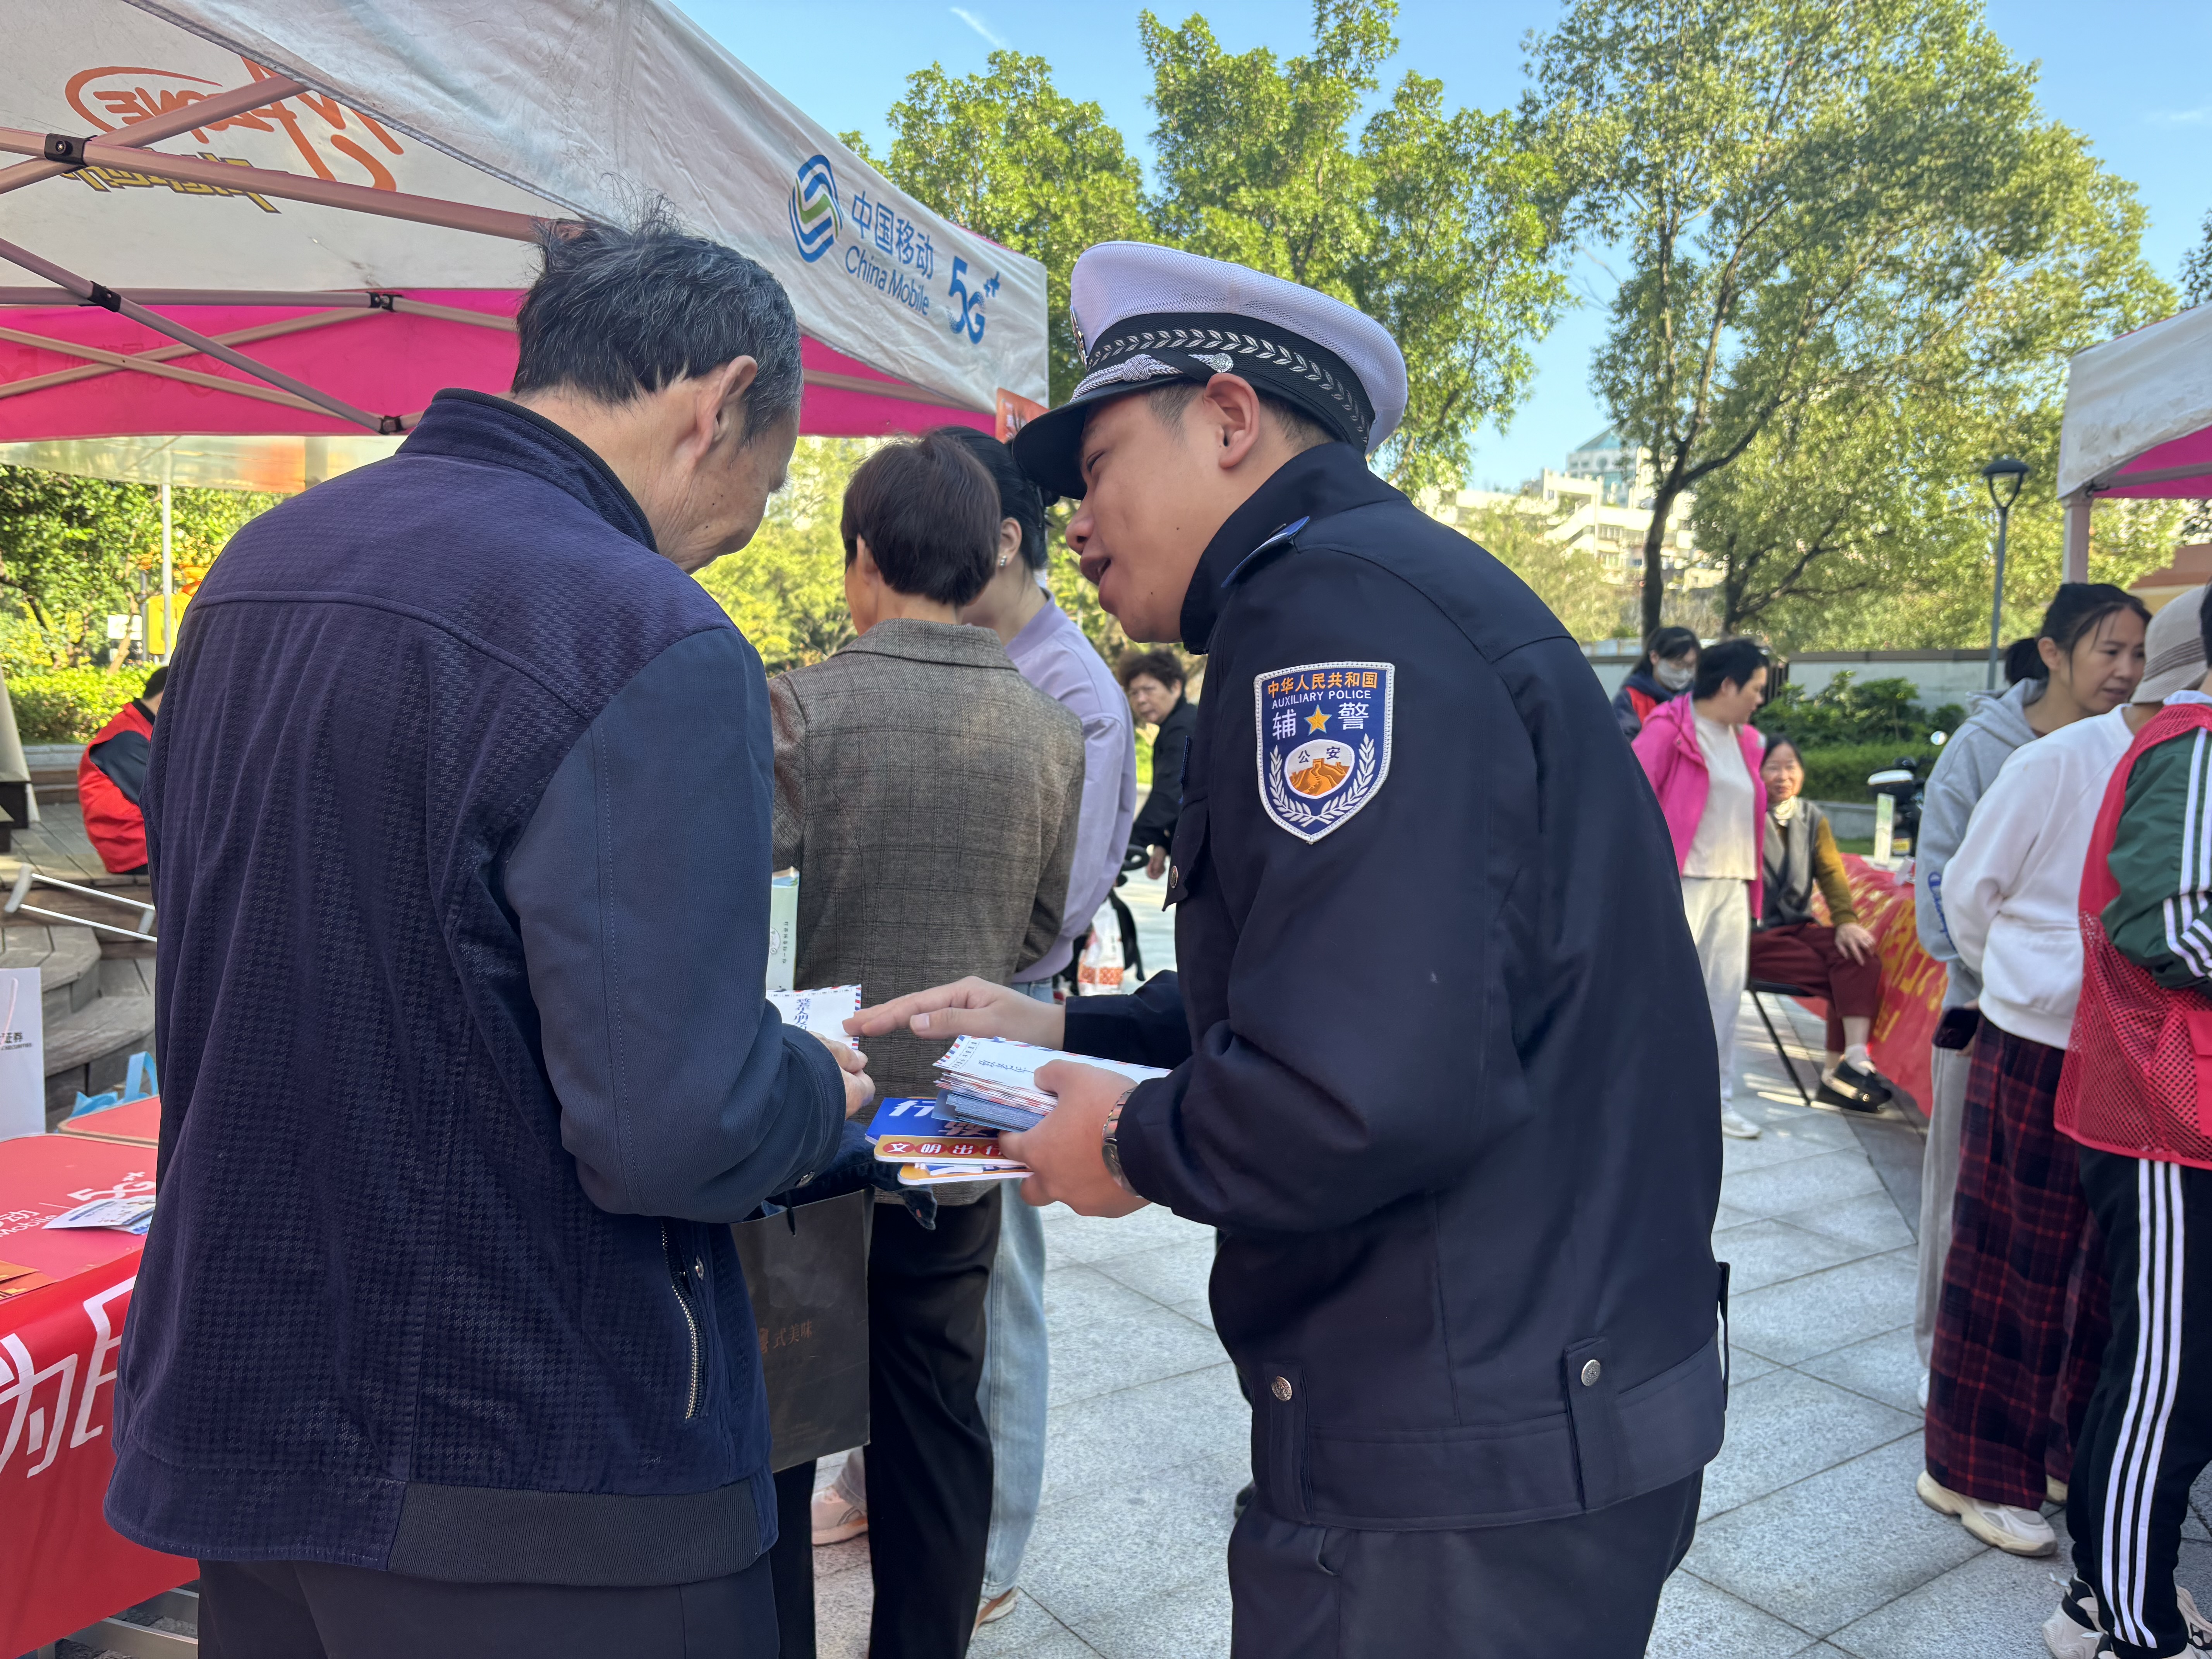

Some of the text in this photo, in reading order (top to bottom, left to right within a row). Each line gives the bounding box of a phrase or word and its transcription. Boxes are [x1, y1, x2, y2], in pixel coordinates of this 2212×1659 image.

[852, 191, 934, 280] 中国移动
[845, 246, 929, 316] China Mobile
[1267, 672, 1377, 698] 中华人民共和国
[1272, 690, 1371, 709] AUXILIARY POLICE
